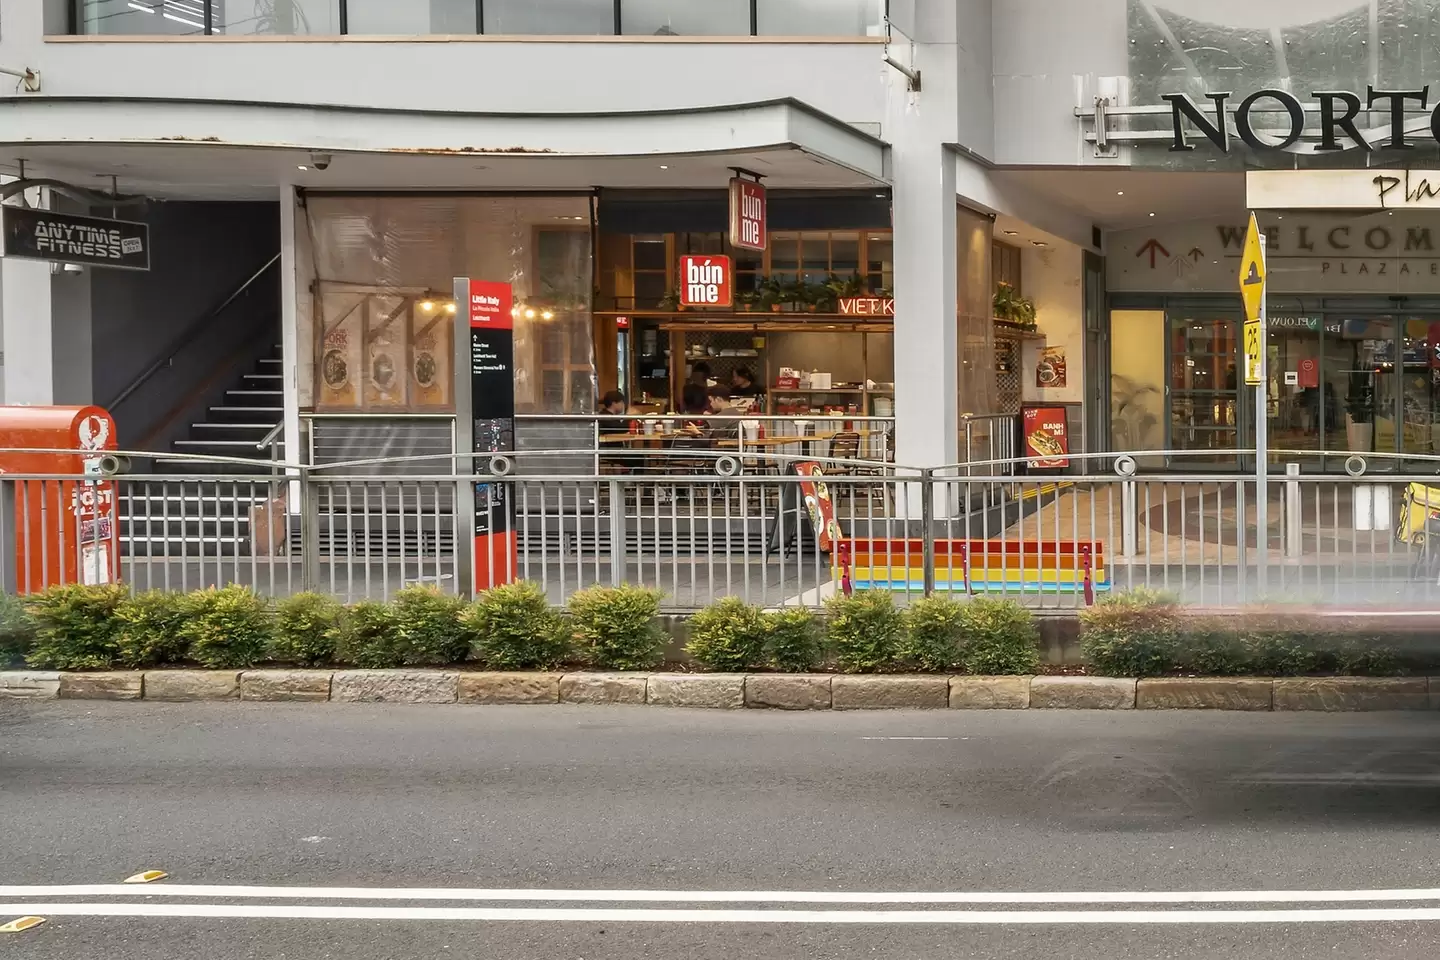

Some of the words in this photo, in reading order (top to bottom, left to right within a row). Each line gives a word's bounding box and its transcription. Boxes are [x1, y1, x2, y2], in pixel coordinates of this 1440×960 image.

[741, 184, 762, 221] bún
[34, 220, 121, 246] ANYTIME
[741, 218, 760, 245] me
[36, 237, 122, 259] FITNESS
[687, 258, 723, 285] bún
[1321, 261, 1411, 276] PLAZA
[687, 283, 719, 303] me
[840, 298, 879, 315] VIET
